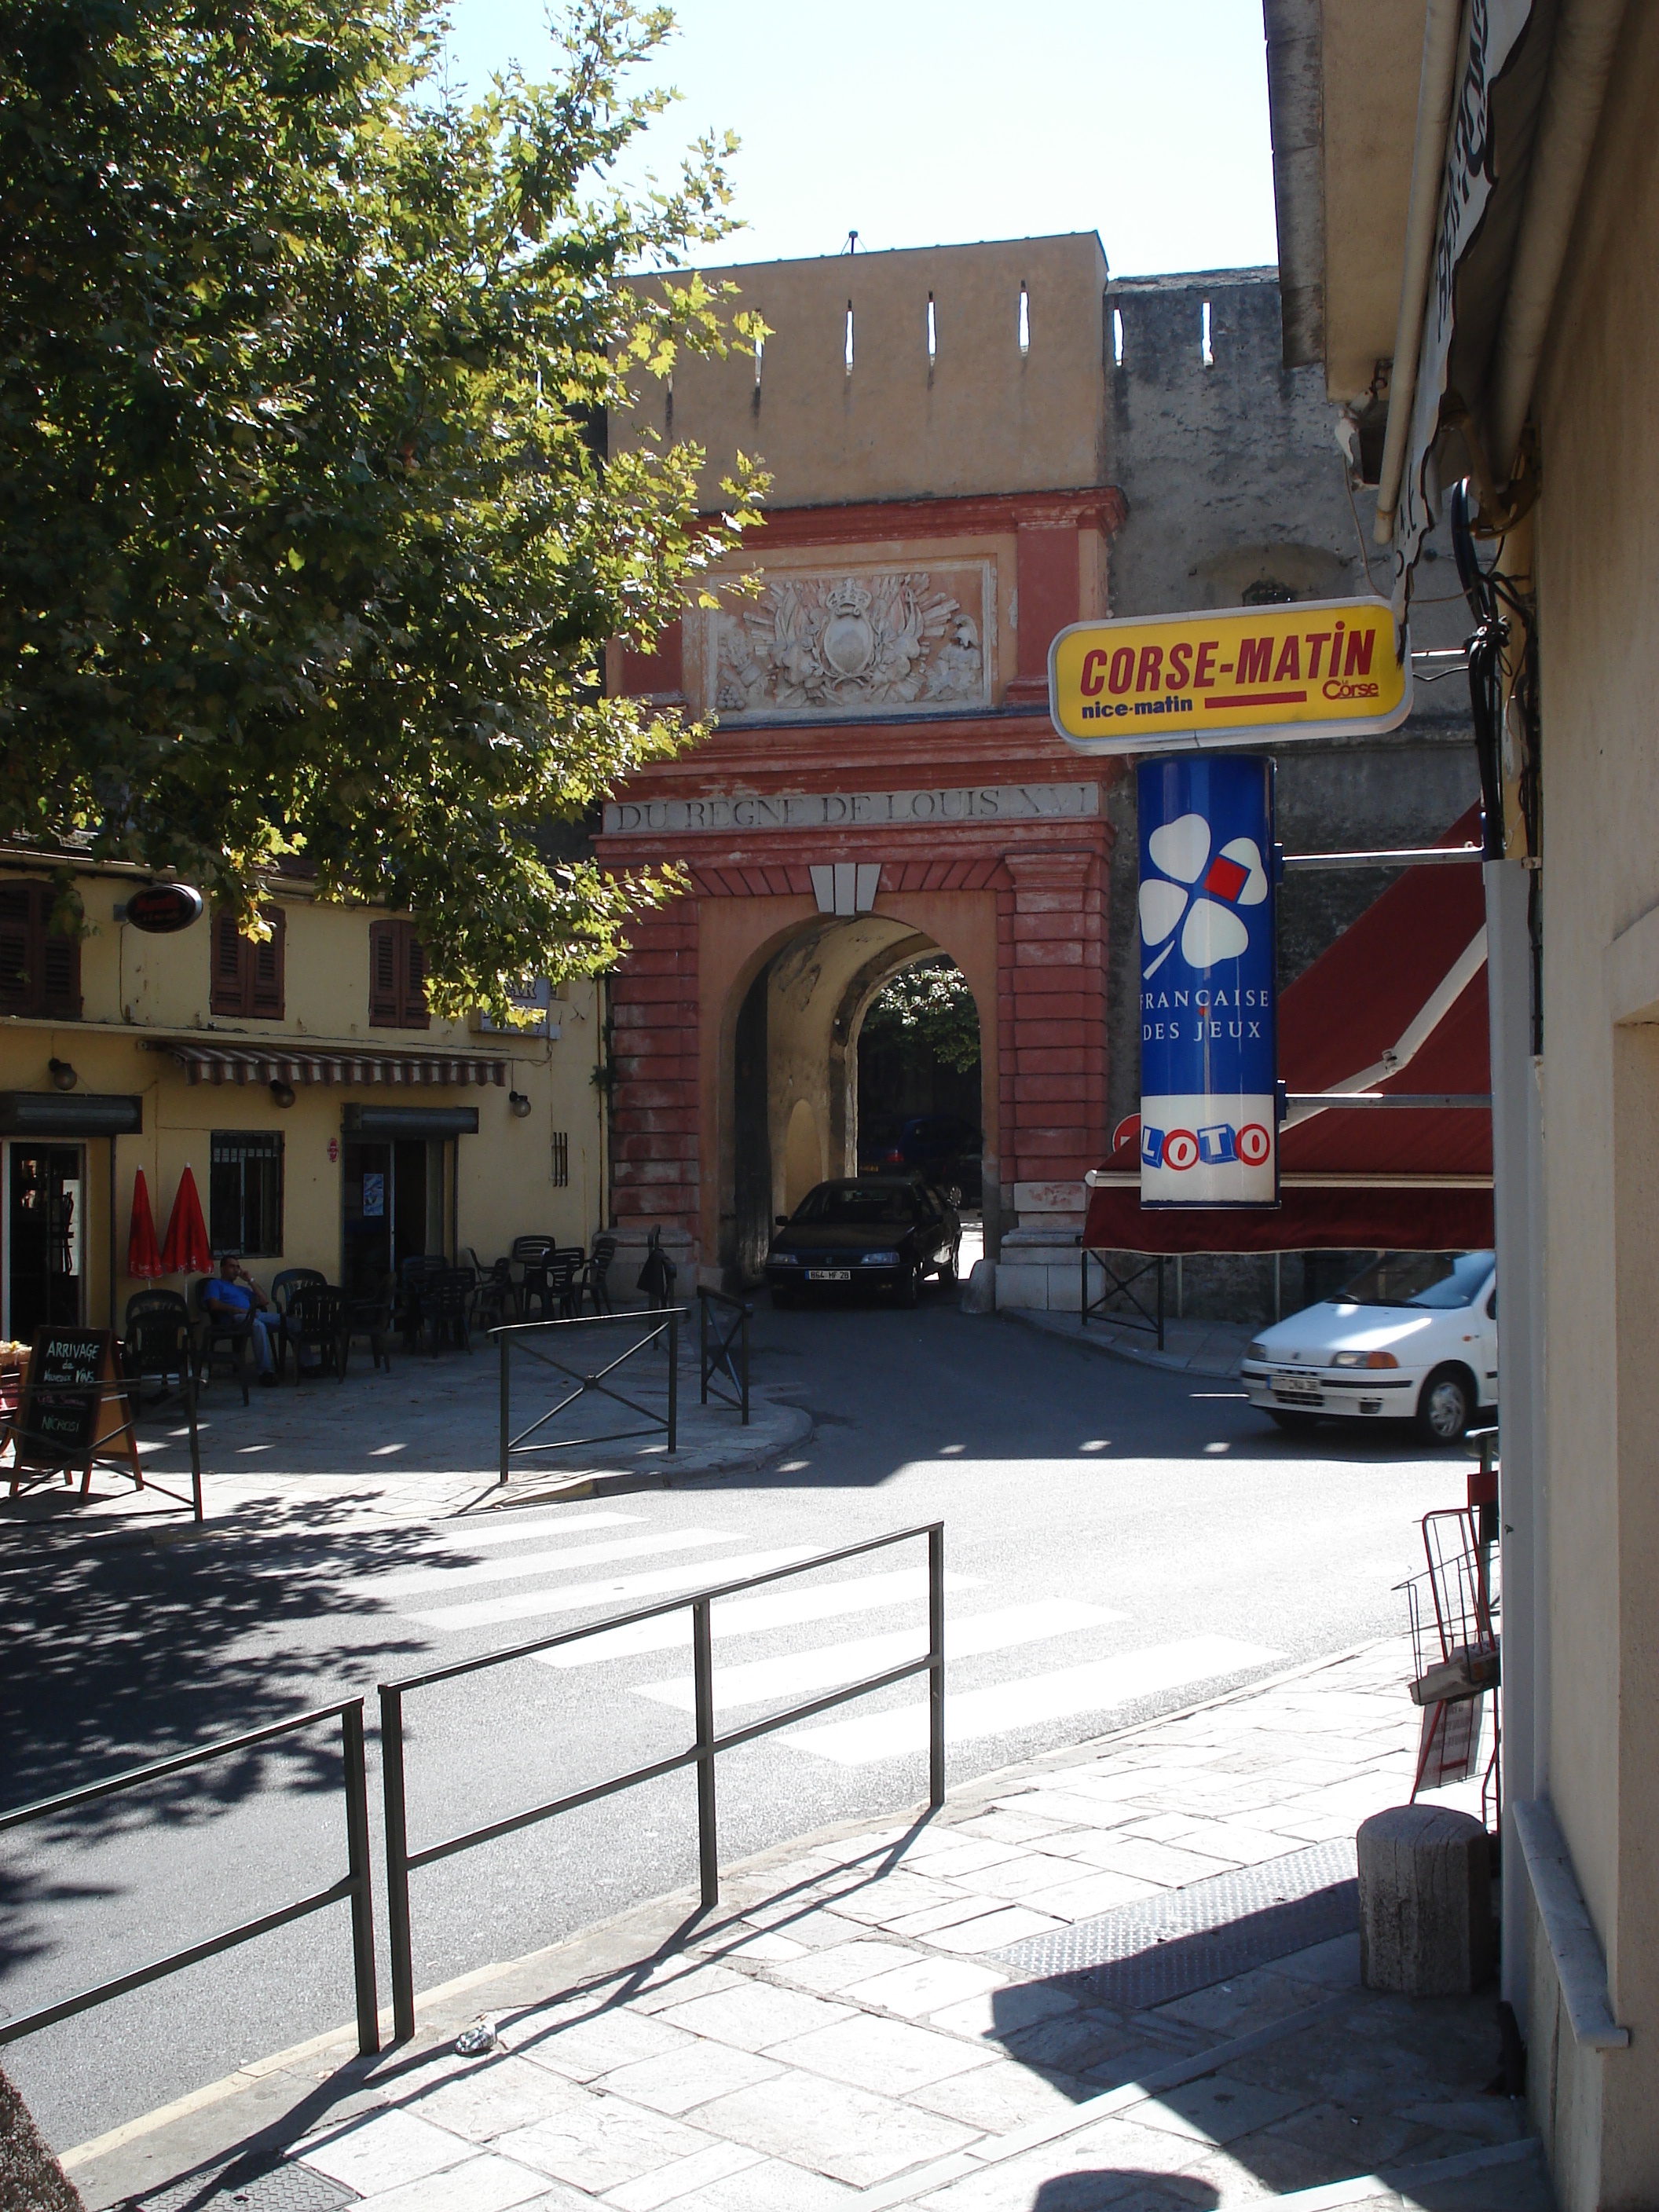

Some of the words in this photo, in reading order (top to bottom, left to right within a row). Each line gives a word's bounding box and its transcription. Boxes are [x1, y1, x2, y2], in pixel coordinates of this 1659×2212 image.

[1080, 621, 1376, 697] CORSE-MATIN
[1323, 679, 1379, 700] Corse
[617, 803, 668, 830] DU
[685, 798, 803, 827] REGNE
[822, 793, 870, 822] DE
[885, 789, 1000, 819] LOUIS
[1017, 786, 1086, 814] XVI
[1143, 1022, 1179, 1041] DES
[1193, 1021, 1261, 1042] JEUX
[1142, 1123, 1270, 1171] LOTO
[46, 1339, 101, 1363] ARRIVAGE
